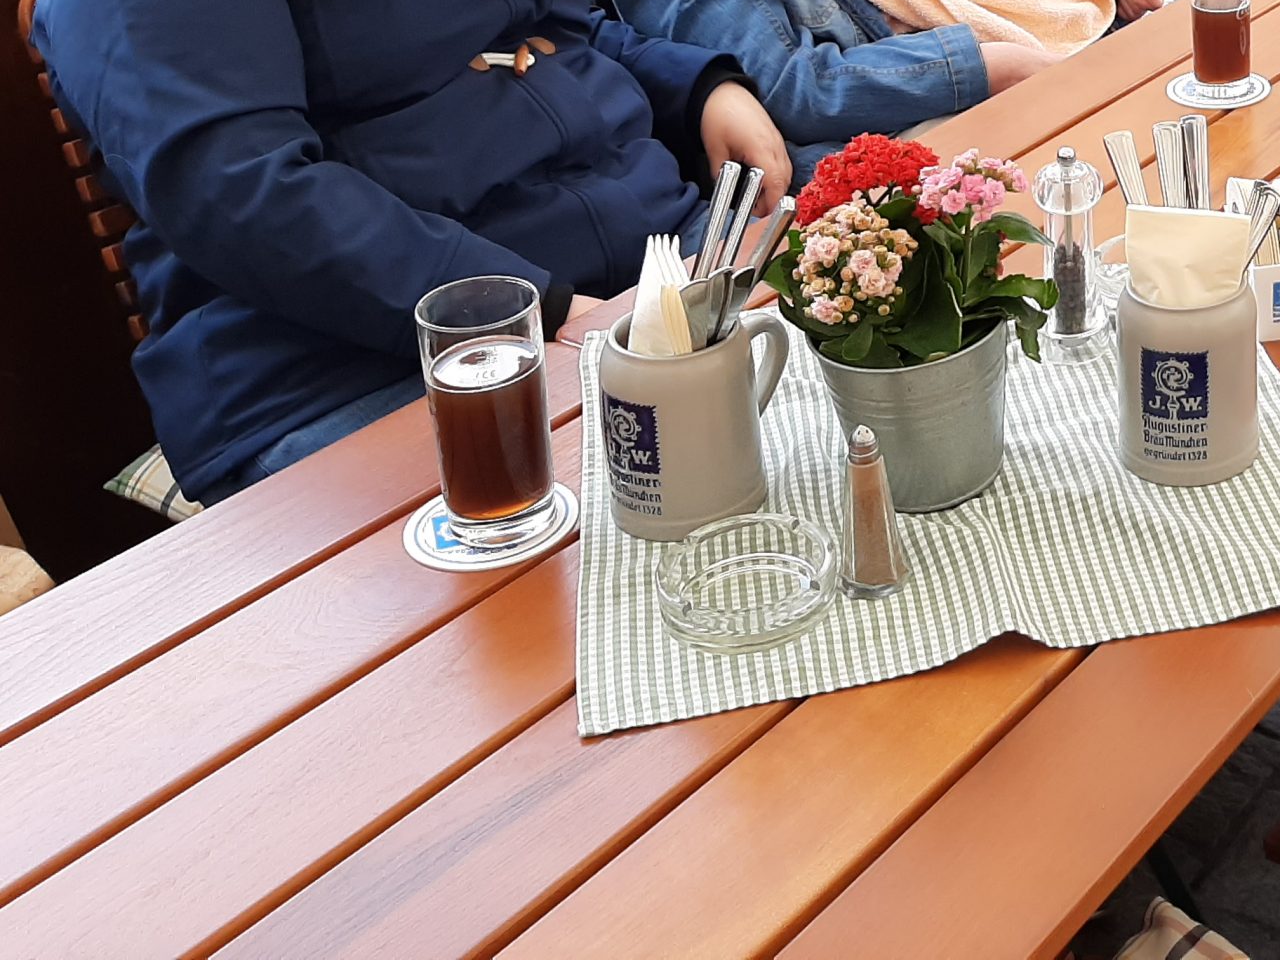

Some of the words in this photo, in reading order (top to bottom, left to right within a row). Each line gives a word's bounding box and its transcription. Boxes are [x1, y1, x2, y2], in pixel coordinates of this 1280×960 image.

[1149, 395, 1166, 410] J.
[1180, 396, 1202, 412] W.
[1144, 429, 1164, 446] Bräu
[1165, 435, 1208, 448] München
[631, 448, 653, 465] W.
[1144, 447, 1186, 460] gegründet
[1188, 450, 1208, 461] 1328
[643, 504, 662, 516] 1328
